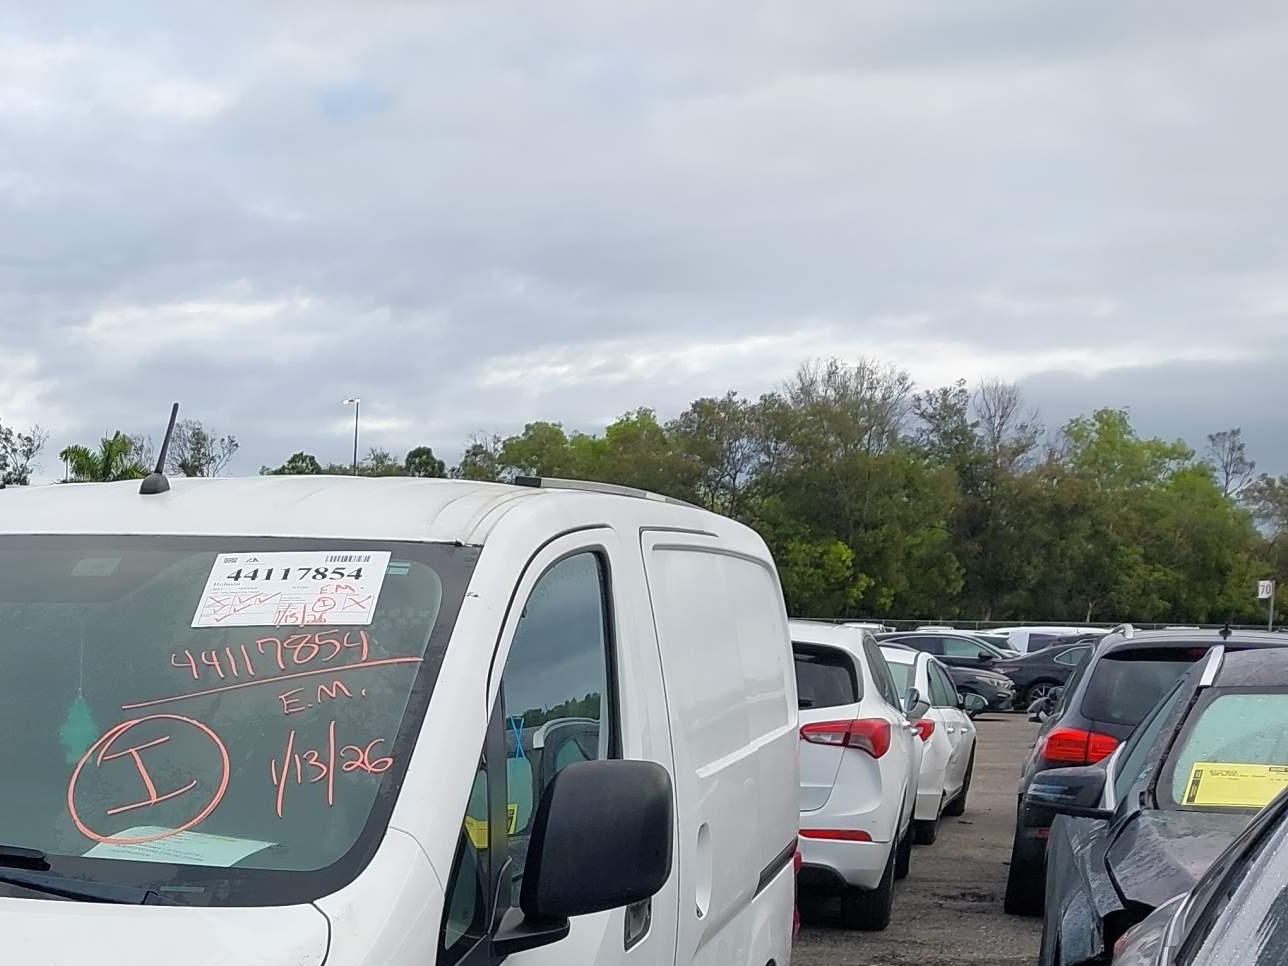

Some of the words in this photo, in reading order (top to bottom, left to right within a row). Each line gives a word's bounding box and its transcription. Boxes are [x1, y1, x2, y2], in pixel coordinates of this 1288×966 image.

[227, 566, 363, 582] 44117854
[171, 630, 370, 680] 44117854
[271, 721, 394, 818] 1/13/26
